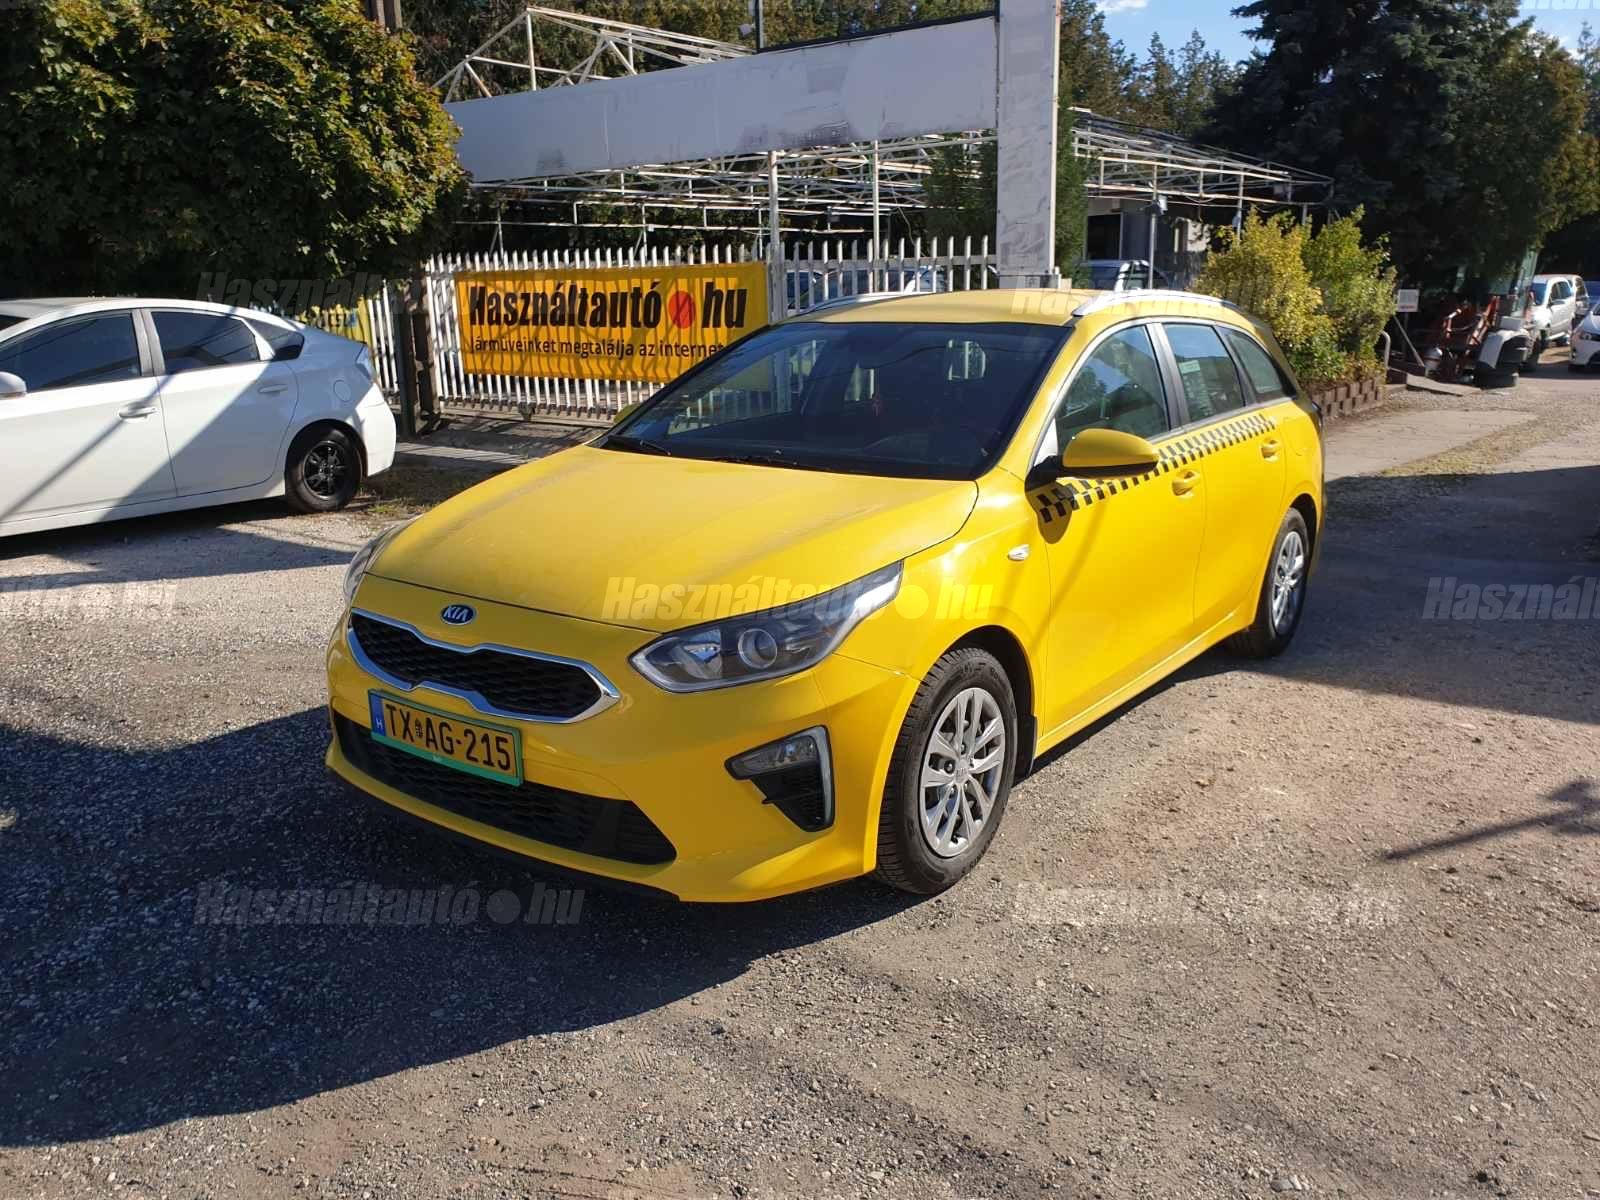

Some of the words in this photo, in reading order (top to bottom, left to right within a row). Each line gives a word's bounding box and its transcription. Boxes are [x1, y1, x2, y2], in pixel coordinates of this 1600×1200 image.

[469, 281, 662, 329] Használtautó
[561, 338, 634, 360] megtalálja
[640, 343, 655, 357] az
[443, 605, 469, 621] KIA
[385, 703, 415, 743] TX
[425, 717, 511, 771] AG-215
